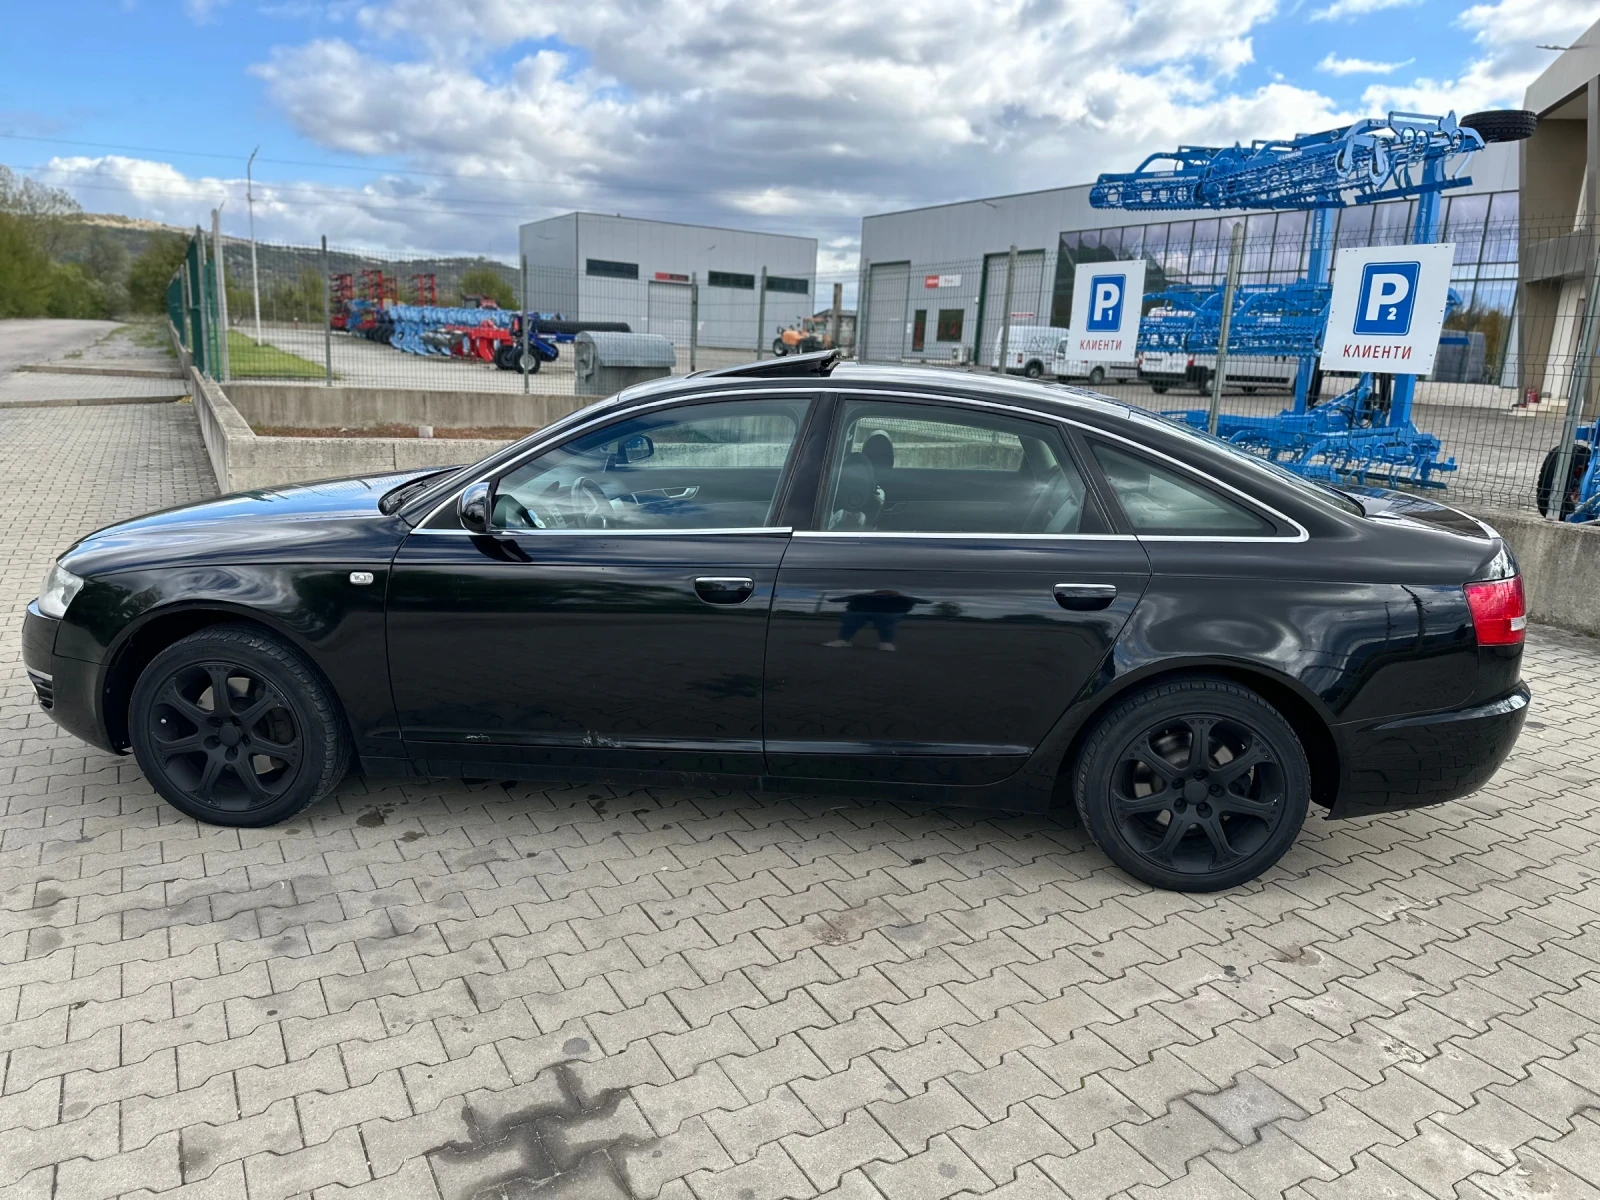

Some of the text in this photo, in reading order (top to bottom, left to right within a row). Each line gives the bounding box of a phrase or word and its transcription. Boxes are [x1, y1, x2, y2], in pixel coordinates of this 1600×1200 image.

[1093, 283, 1120, 321] P 1
[1364, 273, 1409, 321] P 2
[1080, 339, 1122, 351] КЛИЕНТИ
[1343, 344, 1412, 360] КЛИЕНТИ
